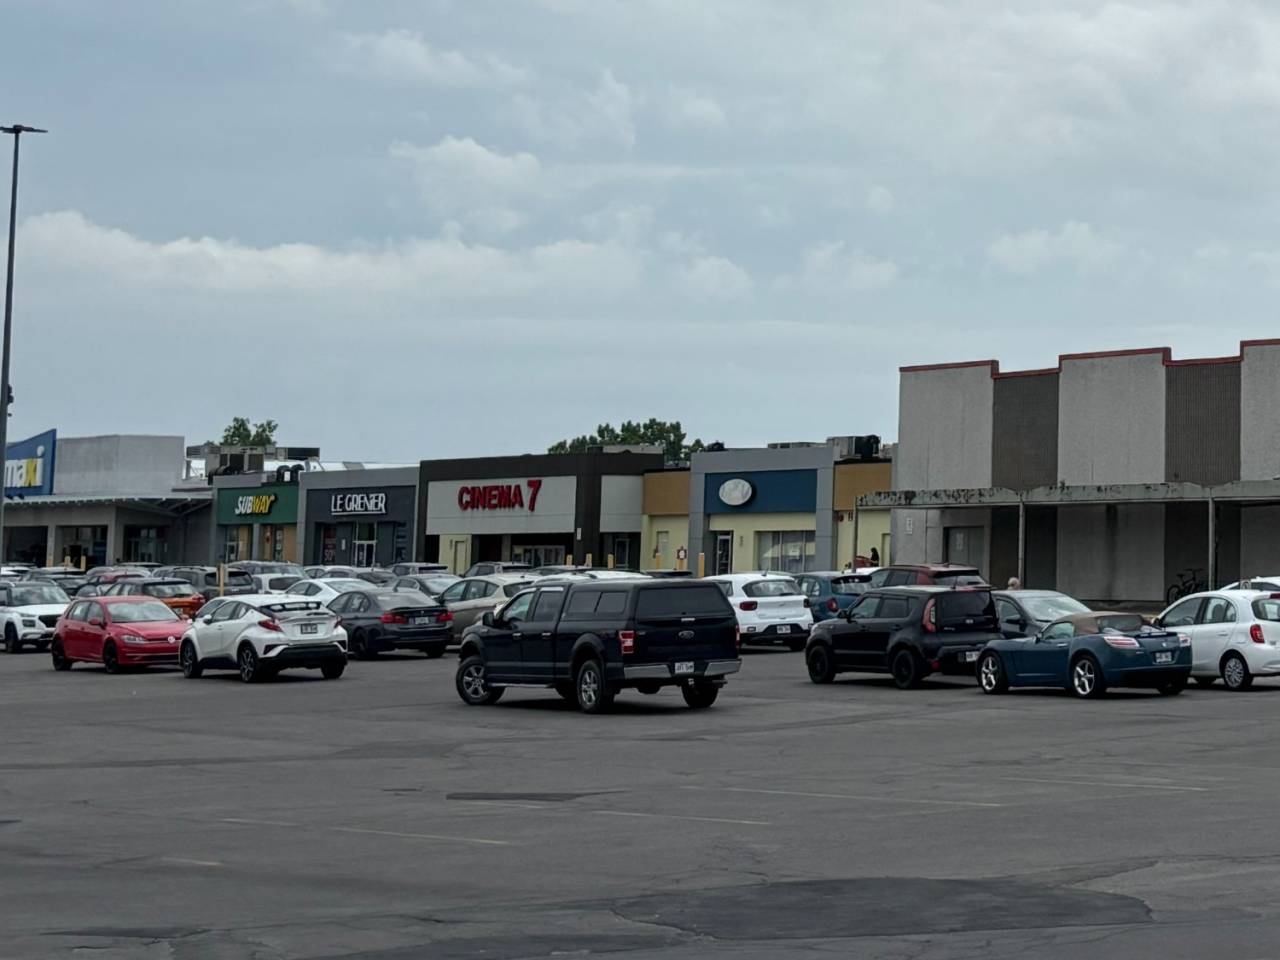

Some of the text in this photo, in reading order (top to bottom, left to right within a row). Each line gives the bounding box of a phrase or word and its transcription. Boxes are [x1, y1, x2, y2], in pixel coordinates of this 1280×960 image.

[5, 445, 44, 488] maxi
[235, 494, 275, 515] SUBWAY
[331, 493, 386, 513] LE GRENIER
[527, 479, 543, 512] 7
